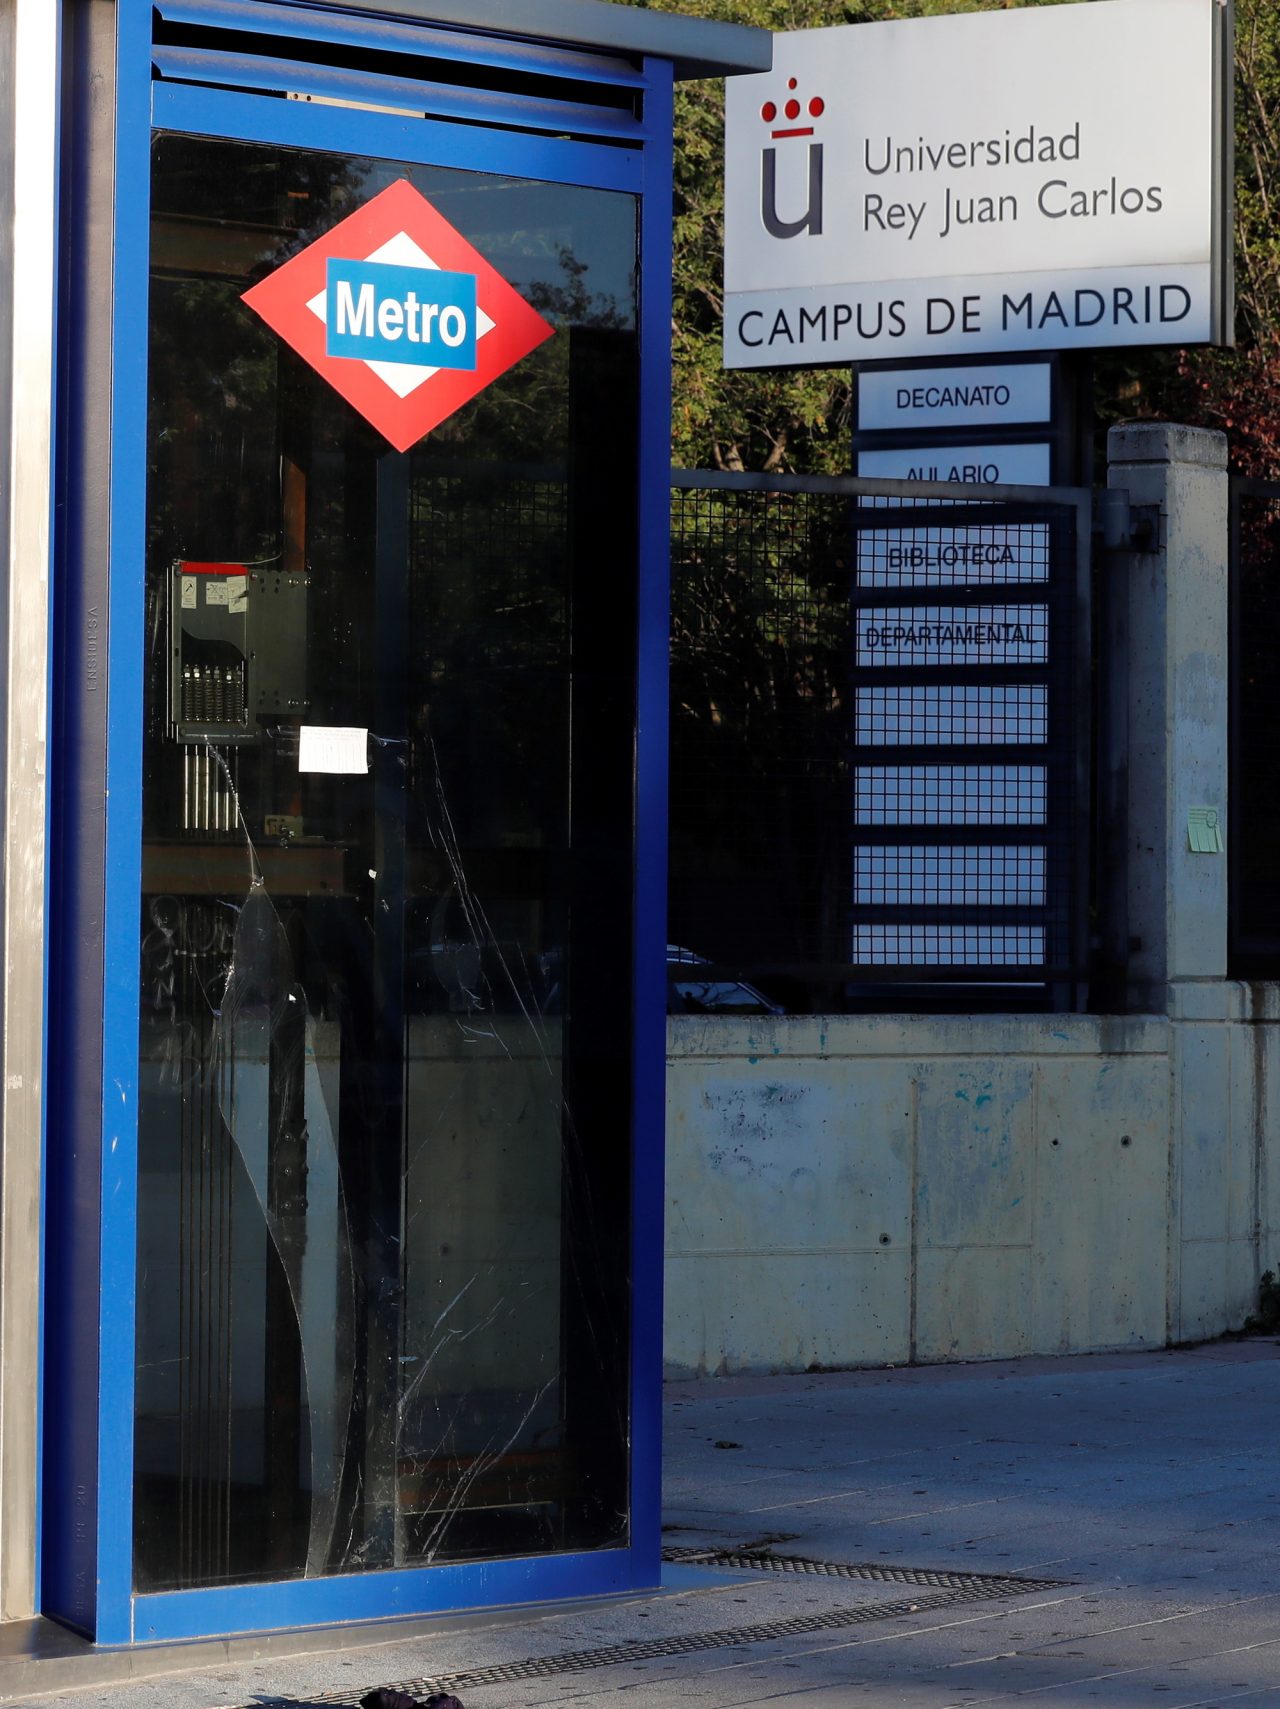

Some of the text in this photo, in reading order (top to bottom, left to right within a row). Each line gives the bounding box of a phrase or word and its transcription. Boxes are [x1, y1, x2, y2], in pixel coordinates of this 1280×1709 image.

[863, 122, 1080, 175] Universidad
[863, 177, 1163, 240] Rey Juan Carlos
[336, 280, 467, 347] Metro
[738, 284, 1192, 347] CAMPUS DE MADRID
[896, 385, 1010, 409] DECANATO
[889, 546, 1015, 568] BIBLIOTECA
[866, 624, 1037, 647] DEPARTAMENTAL
